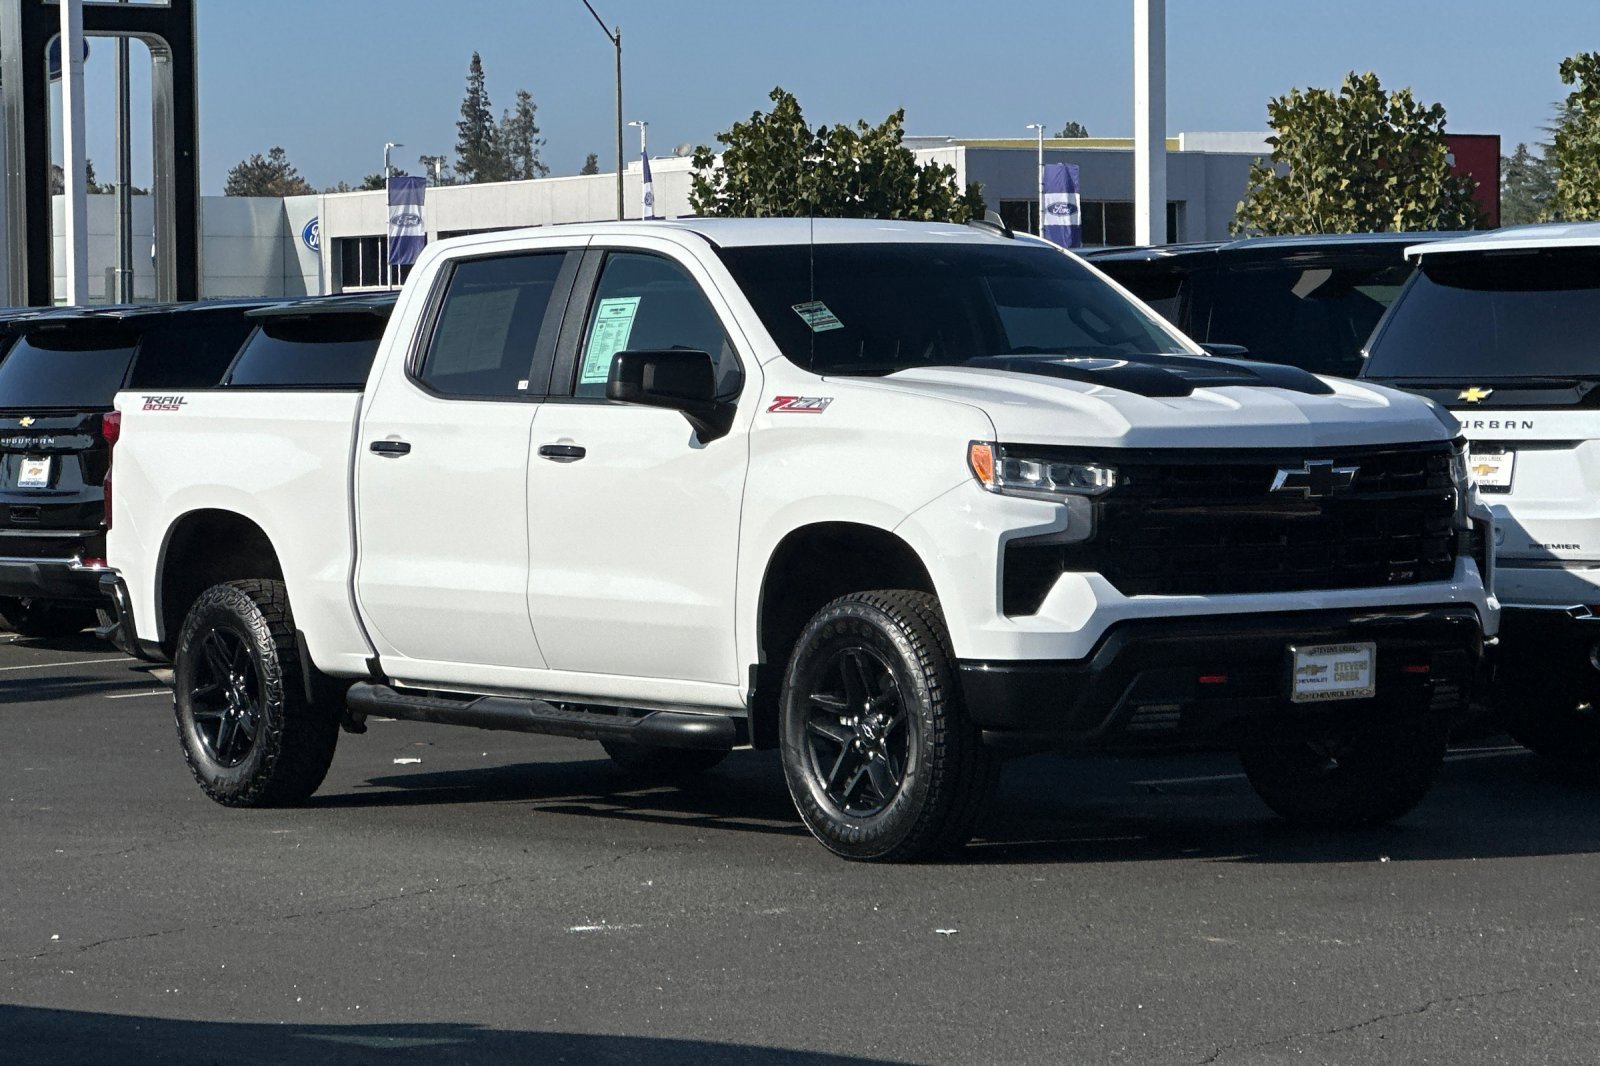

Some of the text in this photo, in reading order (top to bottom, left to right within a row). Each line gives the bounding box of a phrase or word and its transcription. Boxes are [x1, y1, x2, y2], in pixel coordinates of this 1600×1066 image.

[141, 396, 188, 404] TRAIL
[766, 396, 834, 413] Z71
[1312, 645, 1337, 655] STEVENS
[1334, 661, 1368, 671] STEVENS
[1334, 671, 1360, 681] CREEK
[1311, 690, 1355, 699] CHEVROLET
